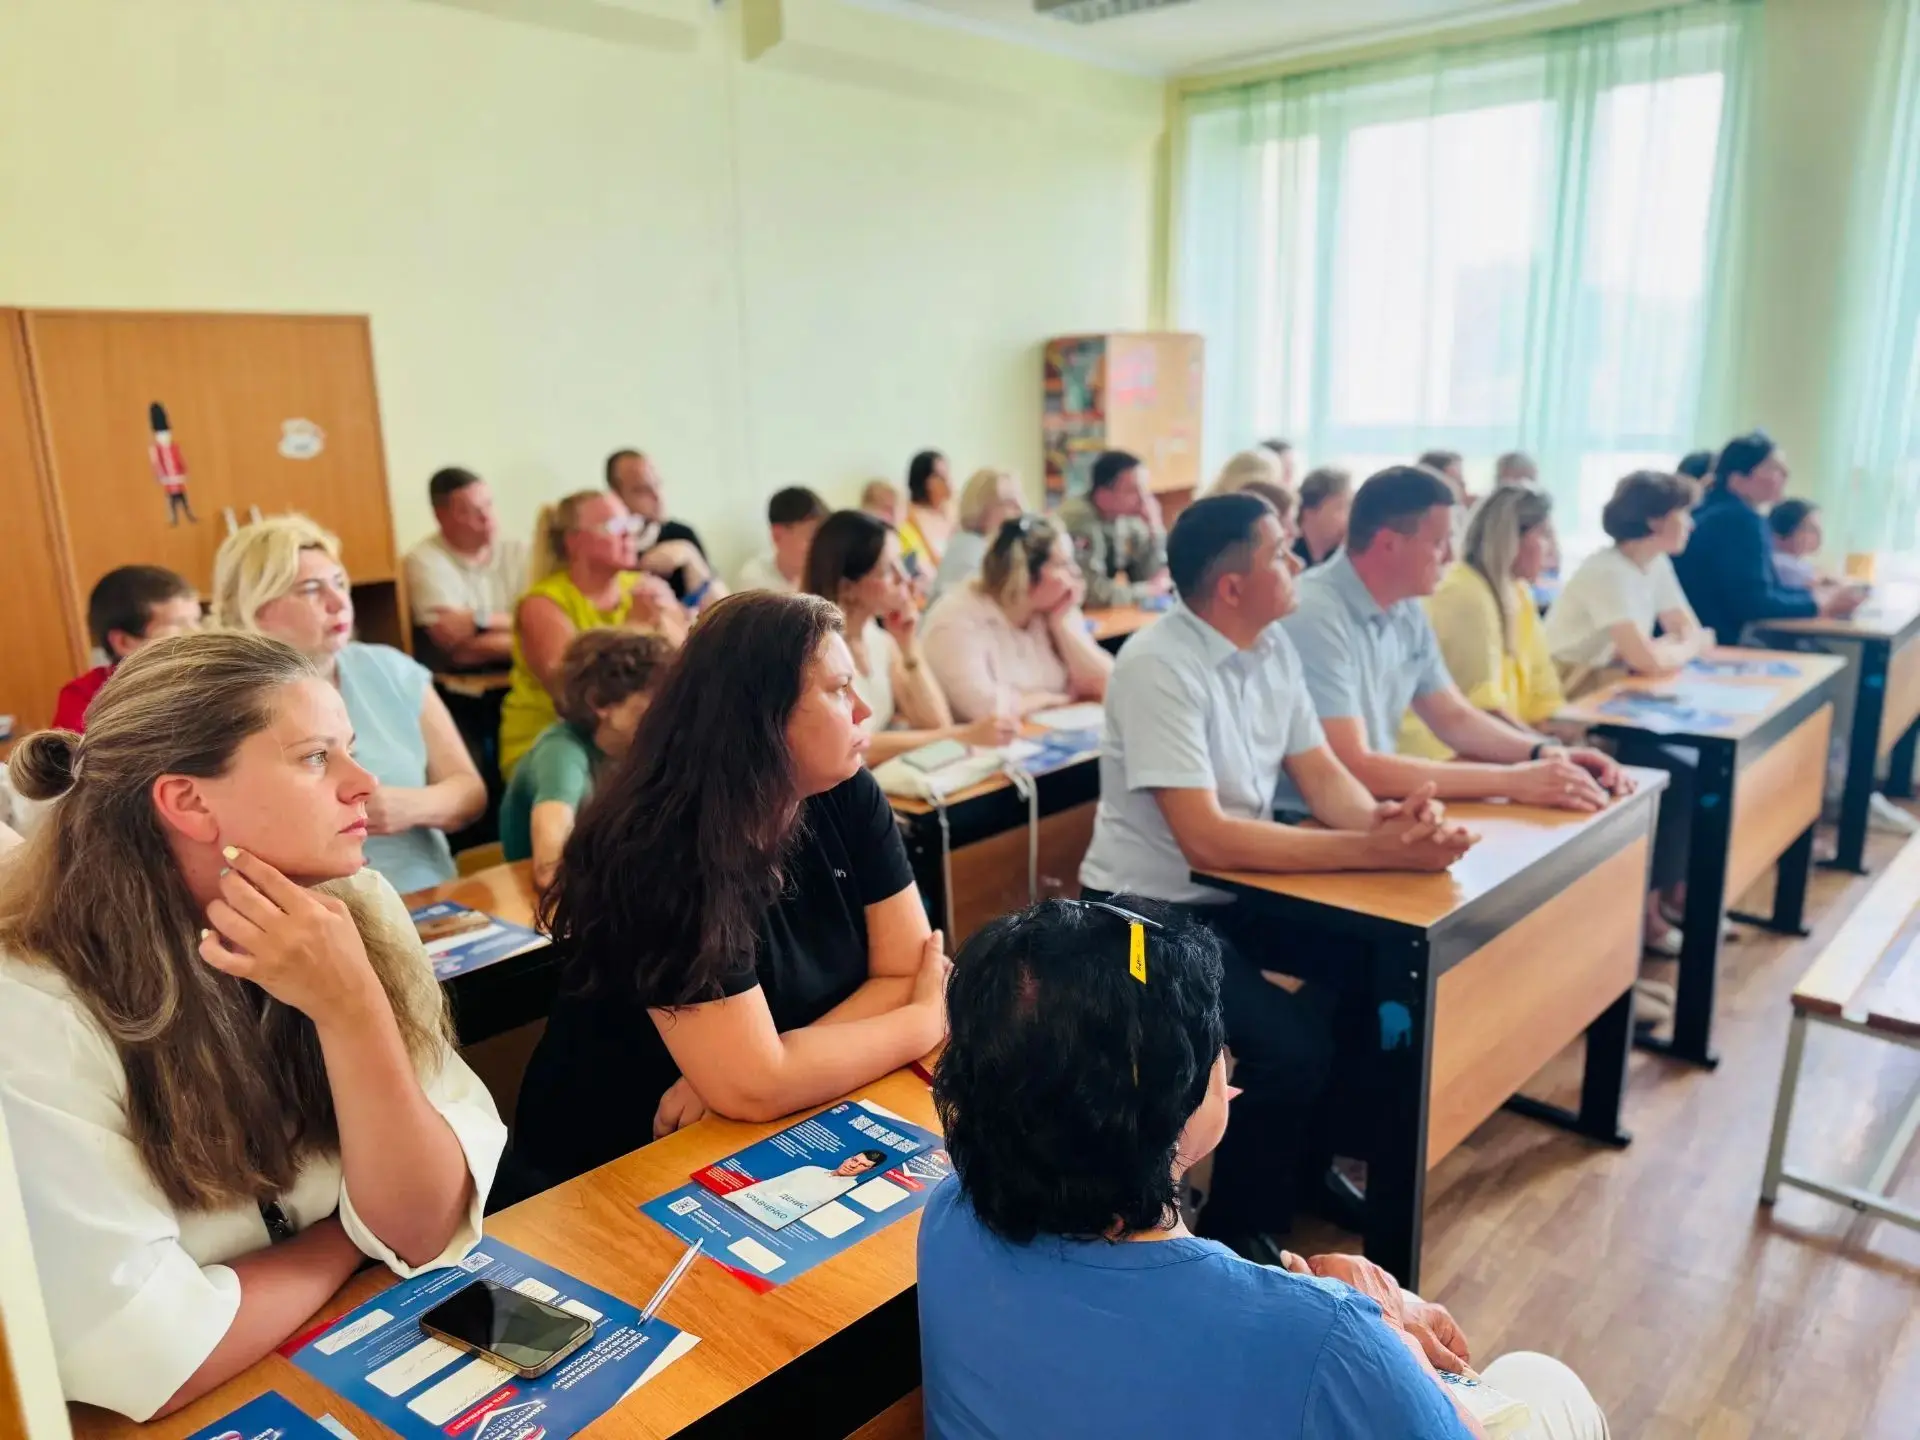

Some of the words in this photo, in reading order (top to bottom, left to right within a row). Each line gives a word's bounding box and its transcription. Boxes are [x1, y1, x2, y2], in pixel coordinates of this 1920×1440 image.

[744, 1192, 788, 1220] КРАВЧЕНКО
[779, 1193, 808, 1210] ДЕНИС
[600, 1333, 630, 1354] НОВУЮ
[613, 1335, 650, 1361] ВНЕСИТЕ
[552, 1352, 601, 1389] ПРОГРАММУ
[561, 1345, 622, 1390] ПРЕДЛОЖЕНИЕ
[481, 1405, 531, 1440] МОСКОВСКА
[511, 1403, 547, 1429] ЕДИНАЯ
